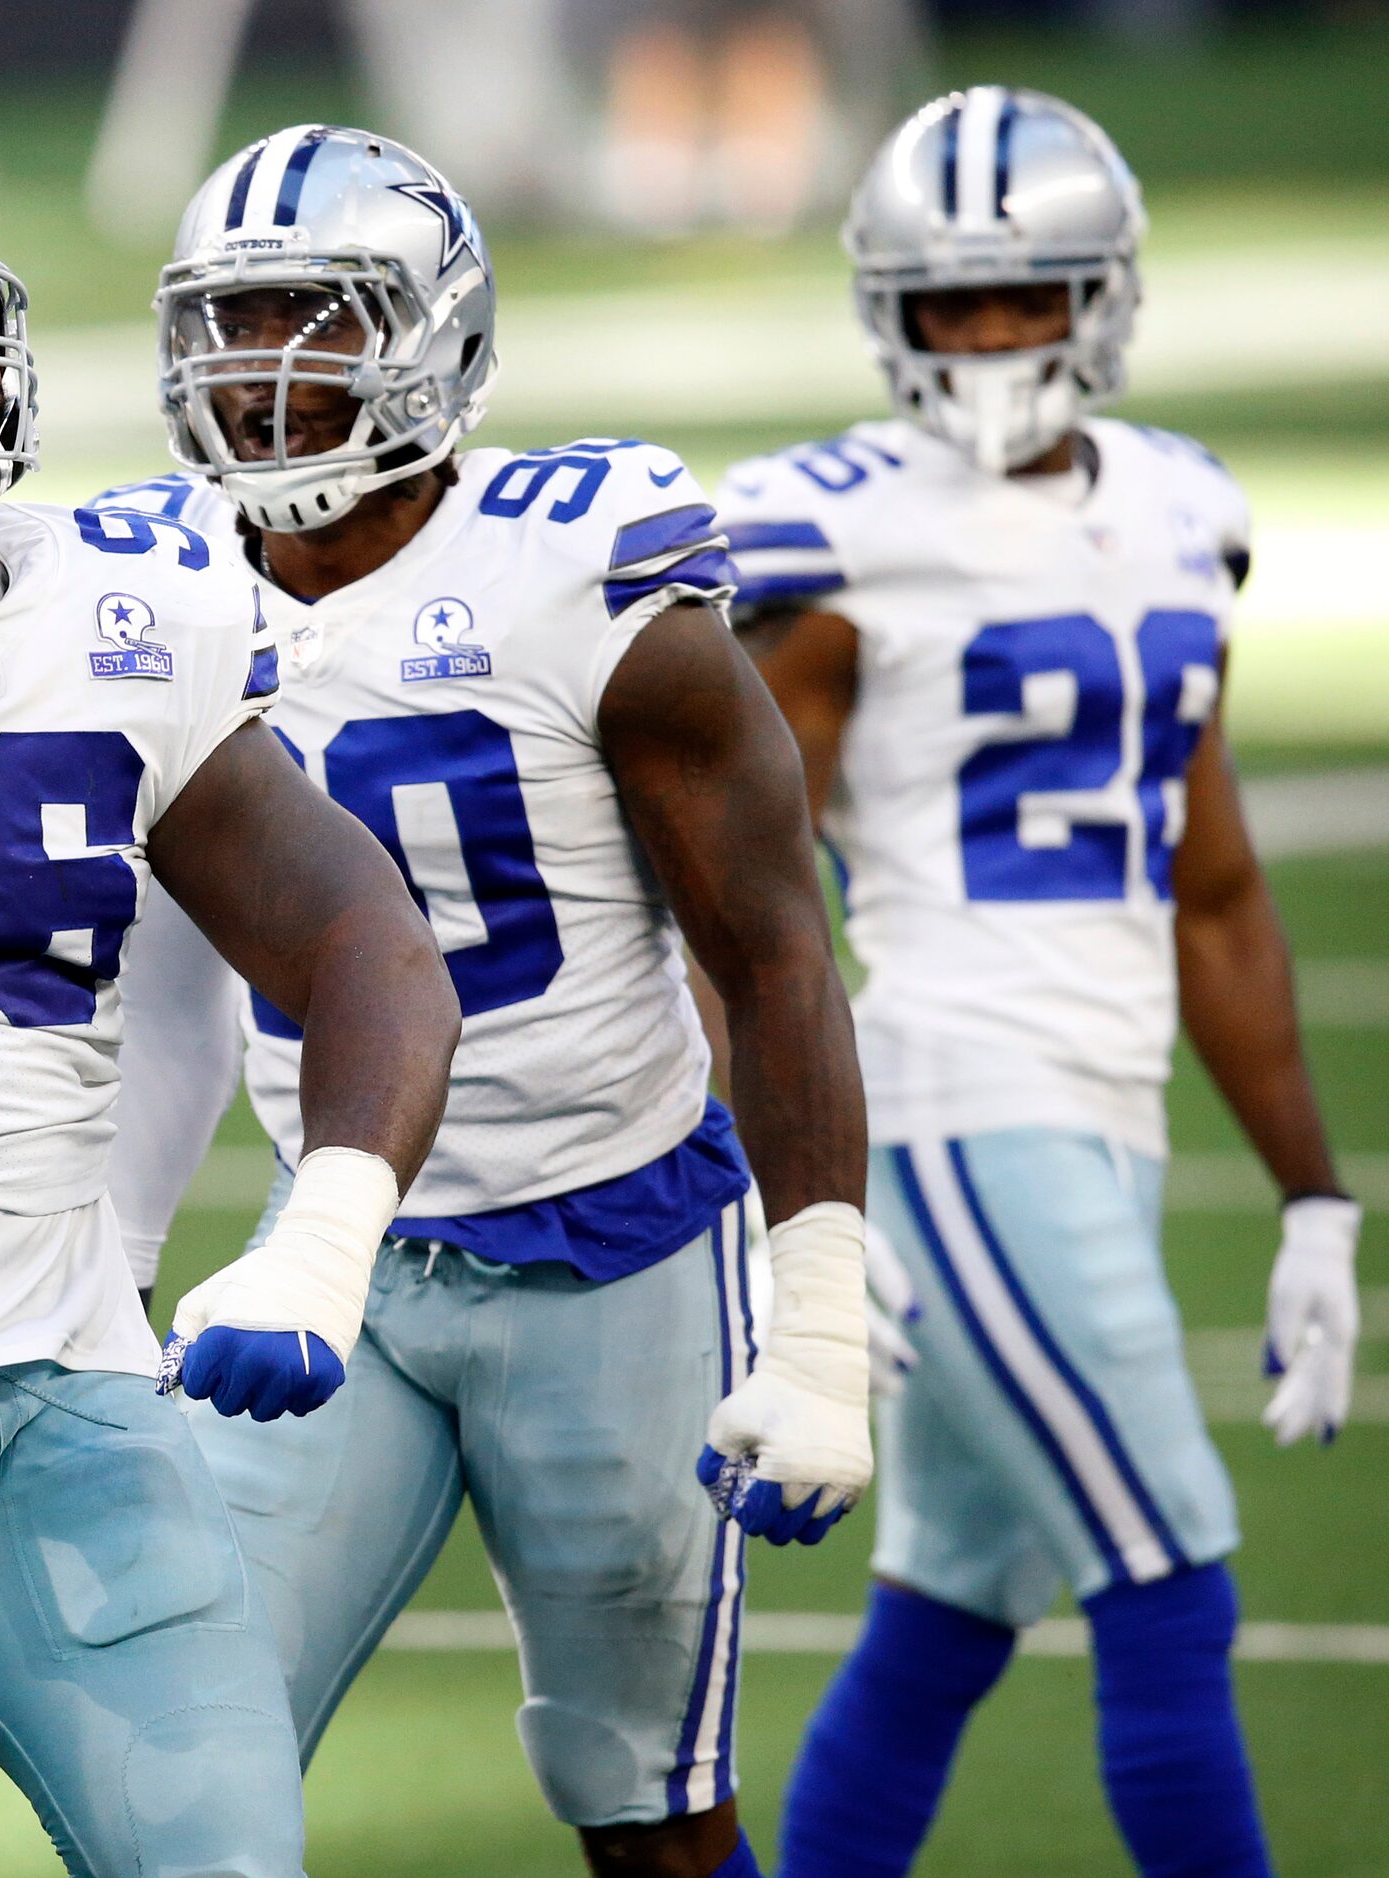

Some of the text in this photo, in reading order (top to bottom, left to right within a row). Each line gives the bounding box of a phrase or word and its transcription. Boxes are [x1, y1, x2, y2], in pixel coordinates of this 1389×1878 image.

[224, 239, 284, 252] COWBOYS
[92, 653, 171, 673] EST. 1960
[402, 655, 490, 680] EST. 1960
